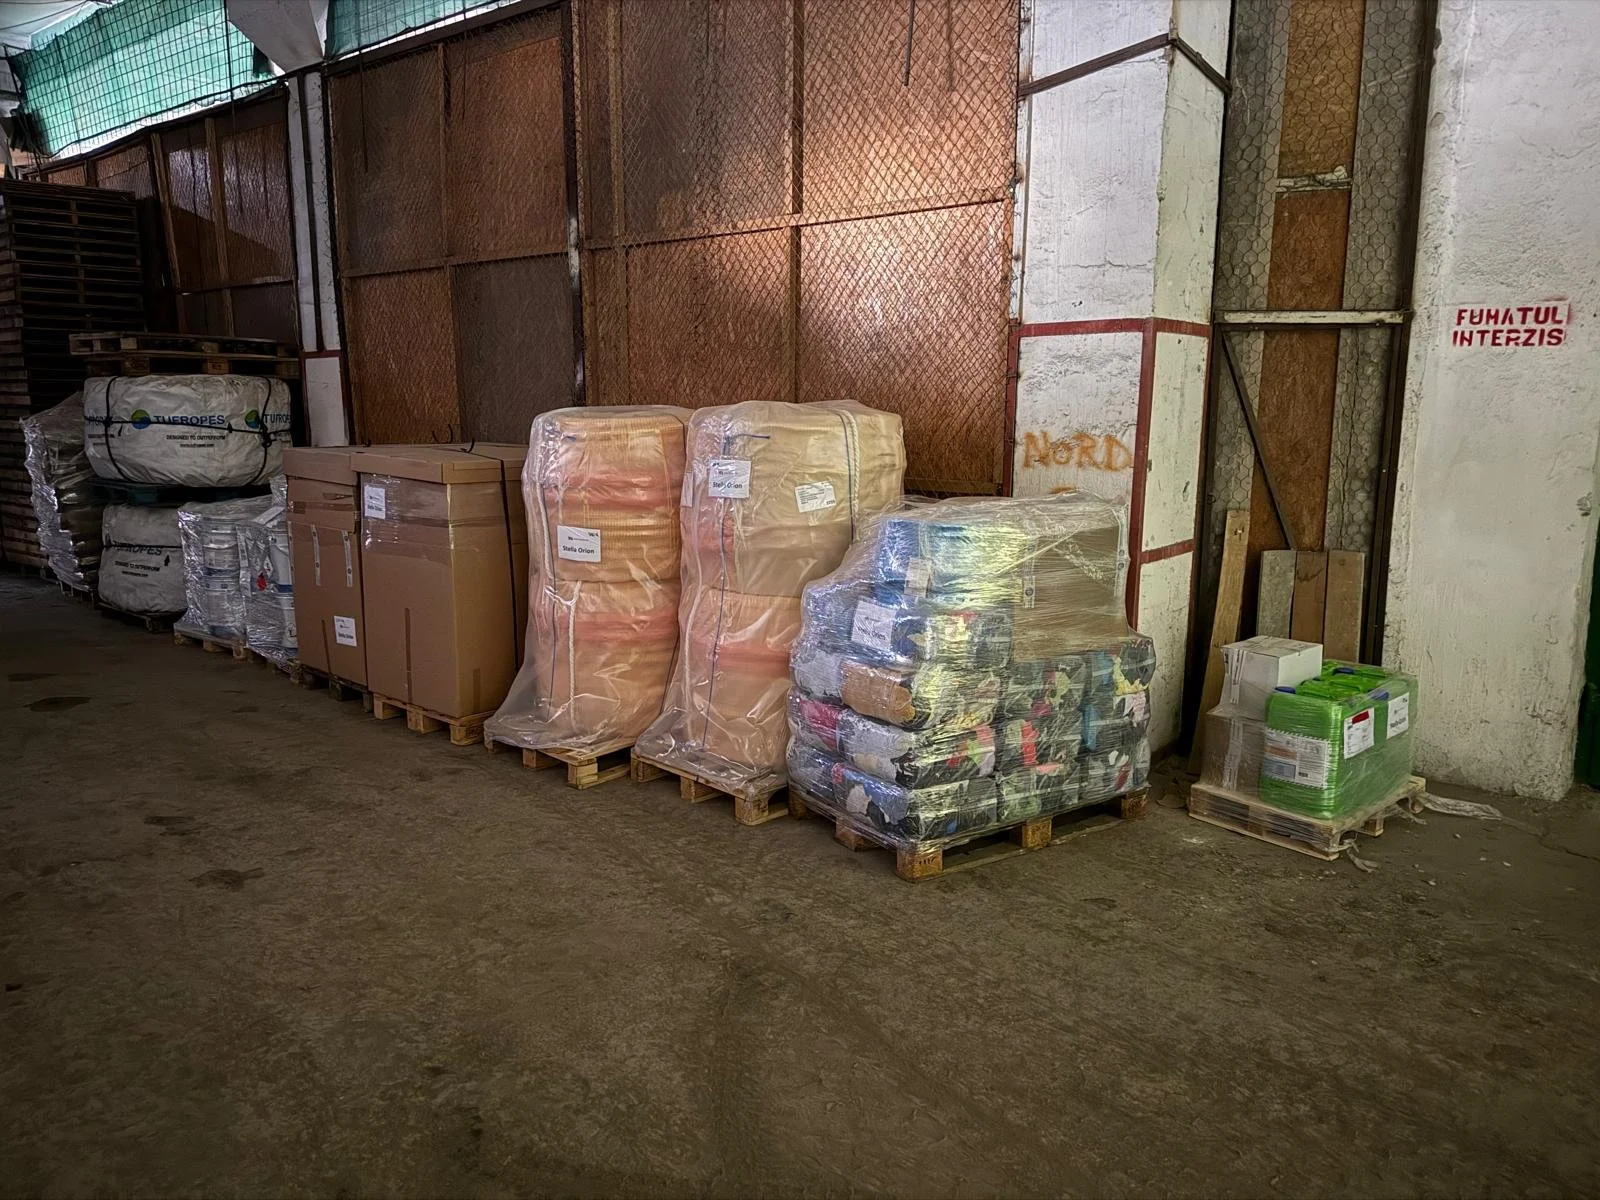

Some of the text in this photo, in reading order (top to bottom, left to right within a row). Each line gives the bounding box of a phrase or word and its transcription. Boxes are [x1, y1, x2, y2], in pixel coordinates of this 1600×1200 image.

[1456, 306, 1564, 326] FUMATUL
[1452, 328, 1564, 347] INTERZIS
[577, 546, 595, 554] Orion
